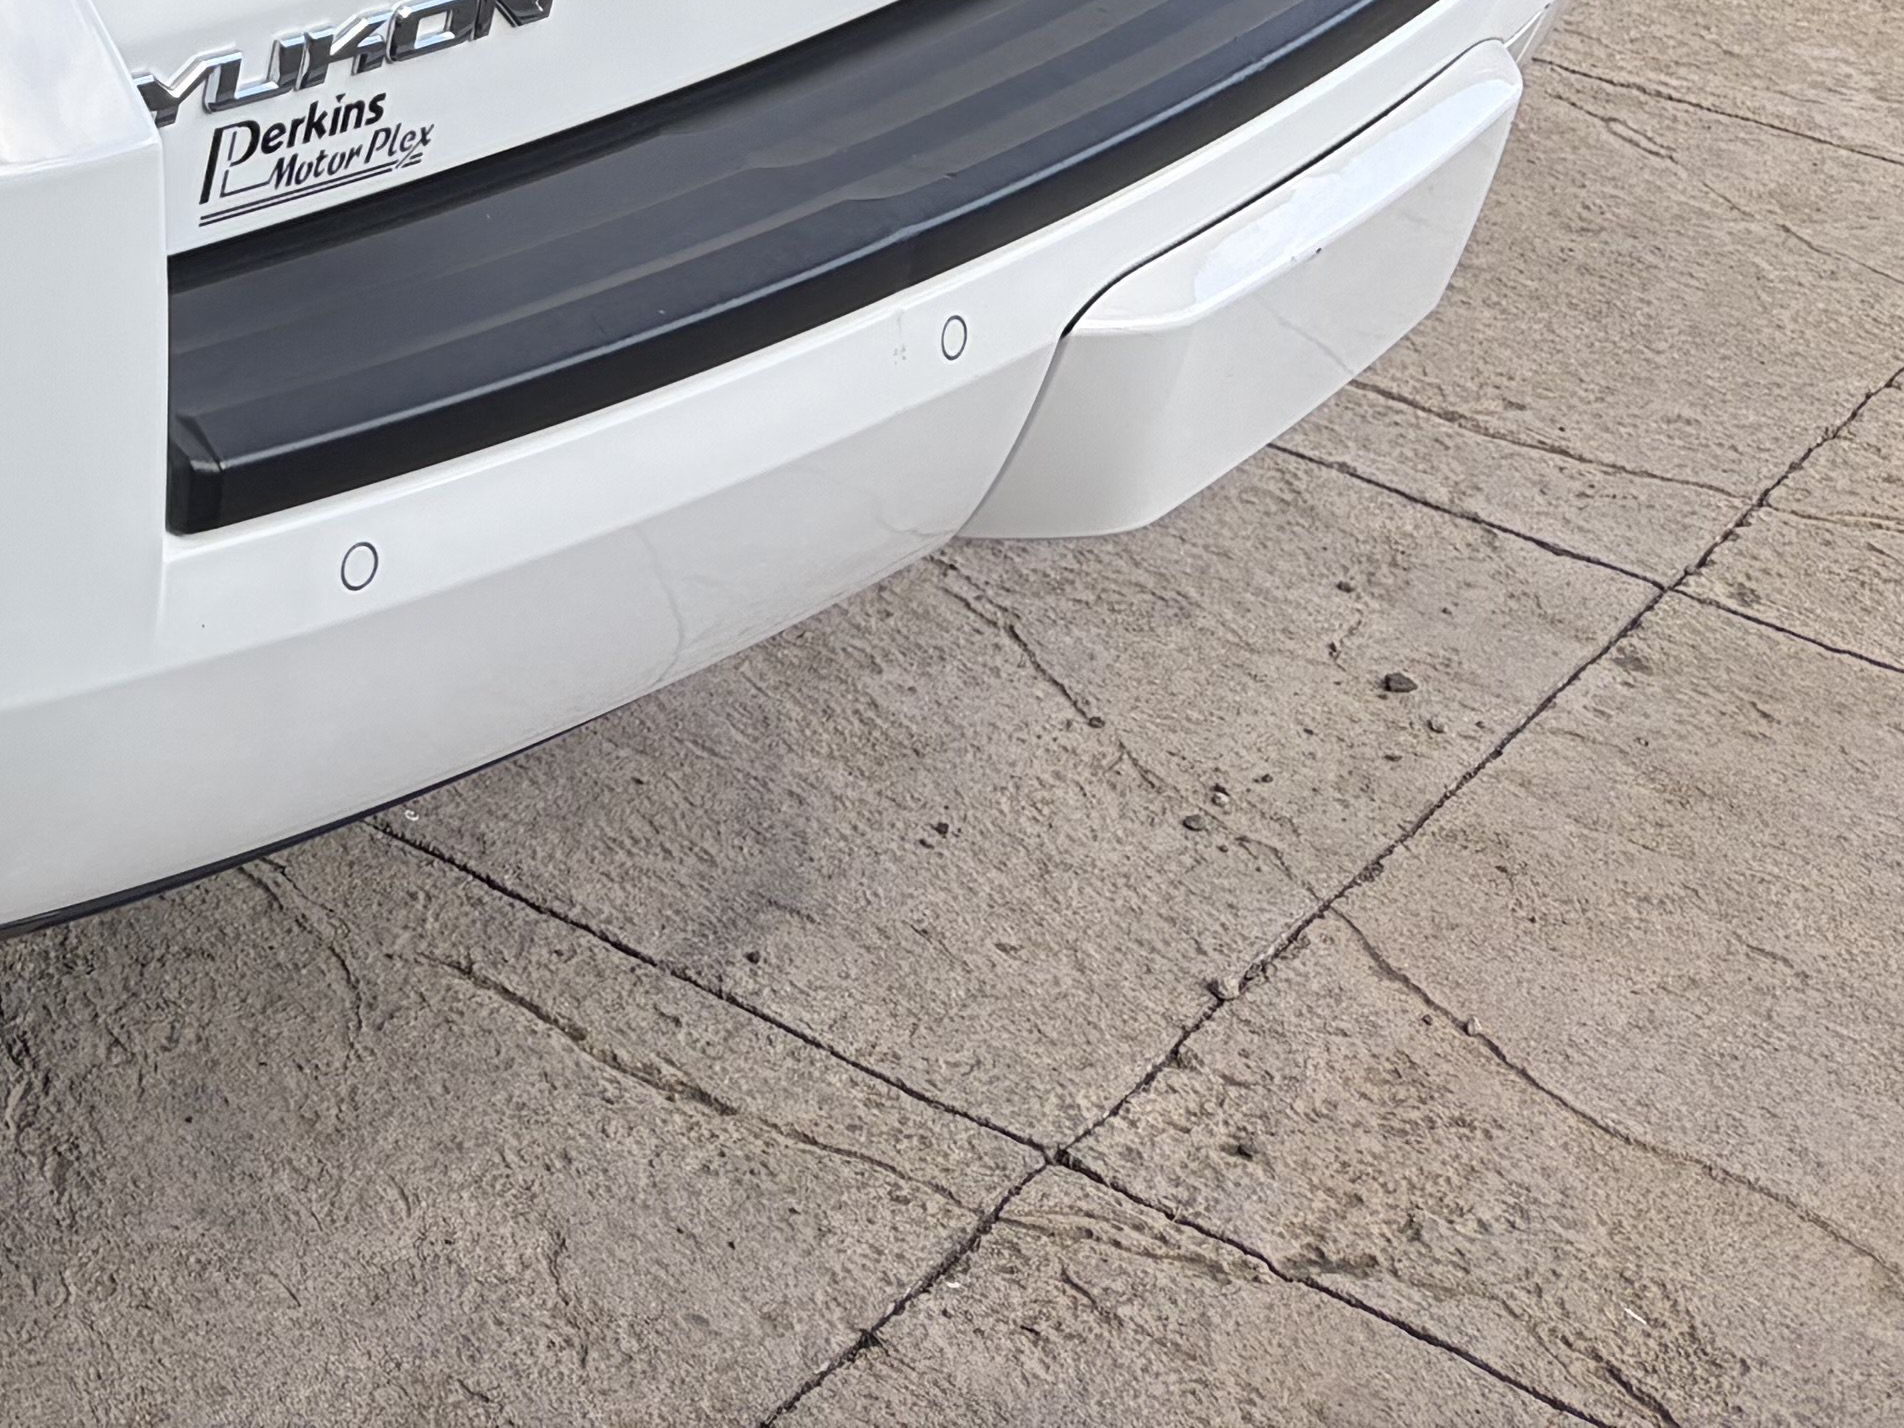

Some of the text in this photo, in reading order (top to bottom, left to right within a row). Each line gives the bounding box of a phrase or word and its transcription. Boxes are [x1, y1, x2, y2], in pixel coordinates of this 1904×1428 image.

[198, 92, 387, 206] Perkins
[271, 123, 436, 191] Motor Plex
